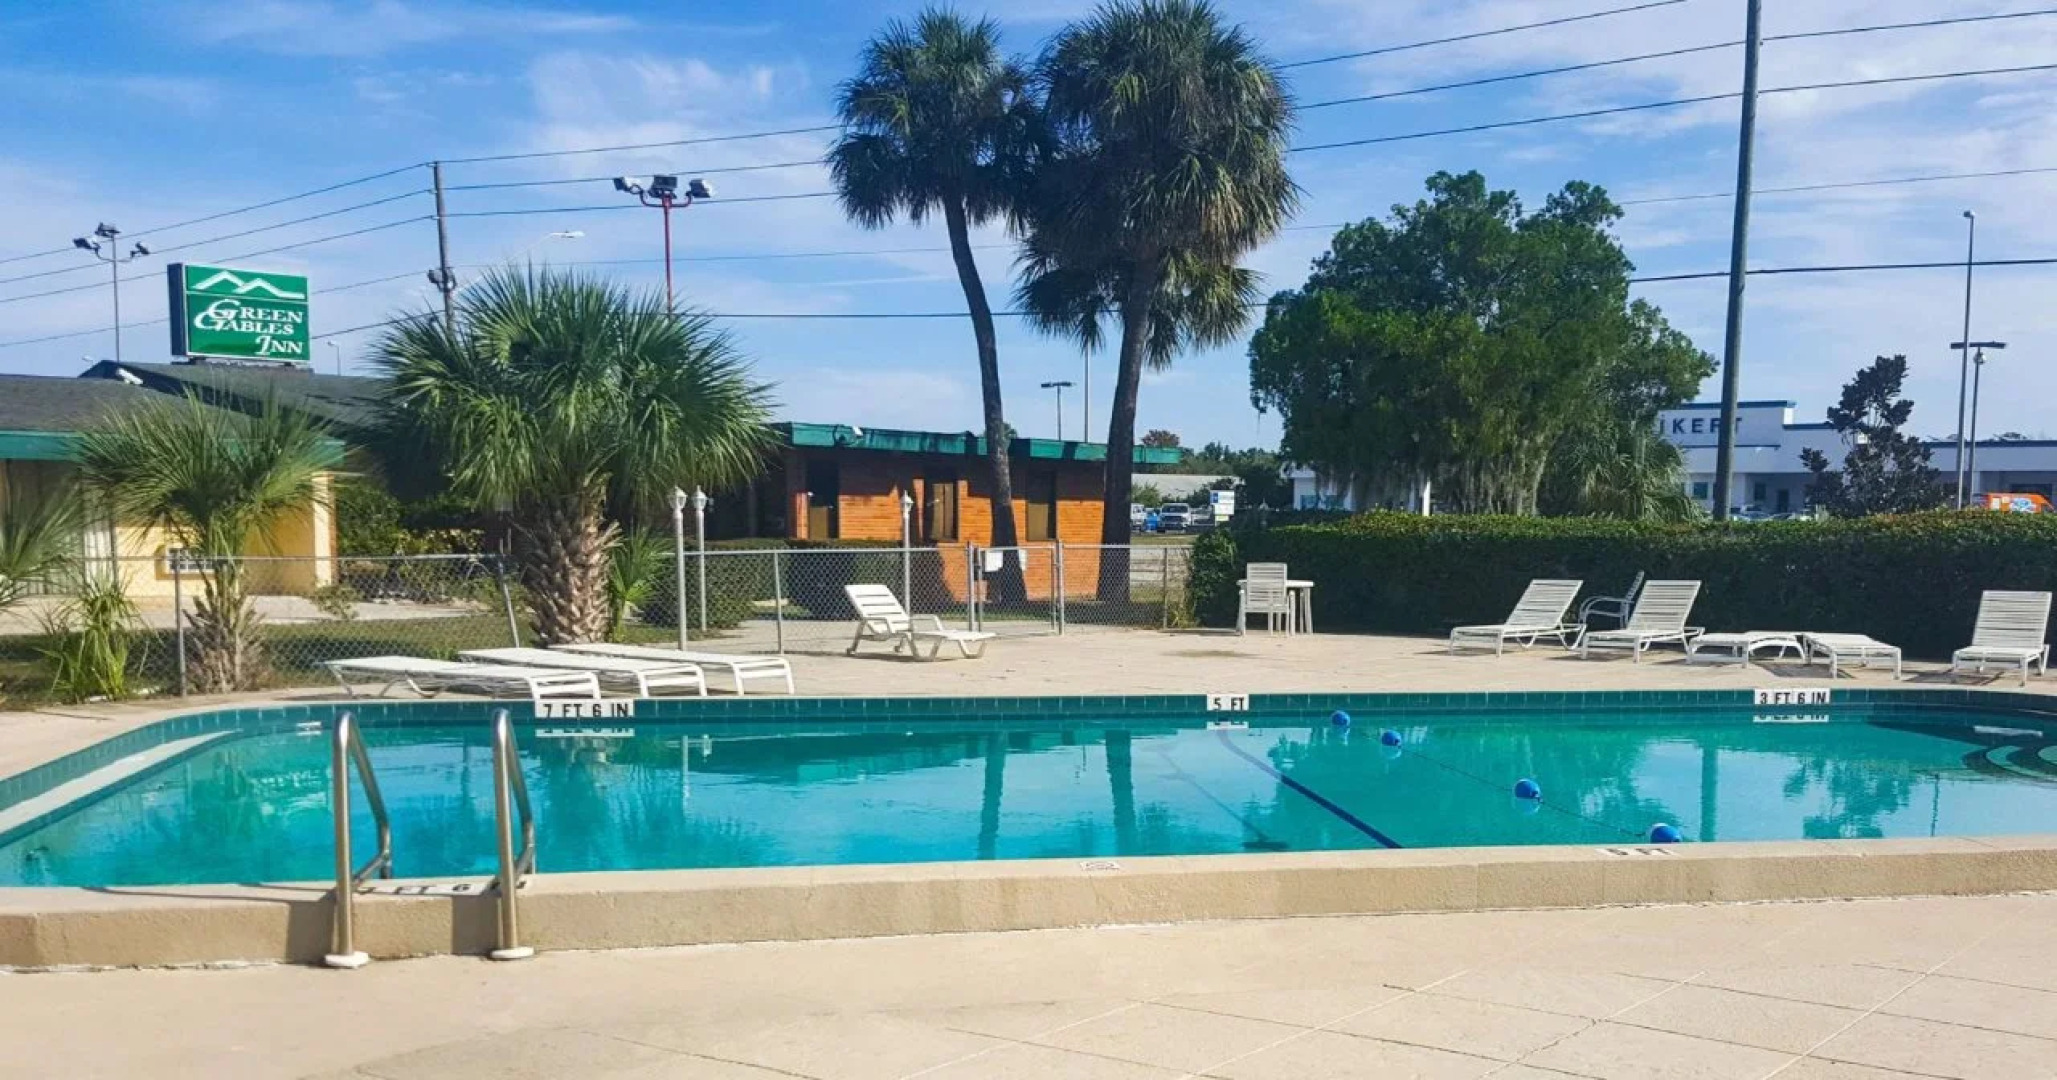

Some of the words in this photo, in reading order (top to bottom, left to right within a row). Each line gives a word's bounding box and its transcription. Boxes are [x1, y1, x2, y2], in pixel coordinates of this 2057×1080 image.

[208, 298, 303, 324] GREEN
[194, 310, 294, 335] GABLES
[255, 335, 303, 356] INN
[1213, 697, 1222, 710] 5
[1230, 697, 1245, 711] FT
[1760, 692, 1769, 704] 3
[1775, 692, 1791, 704] FT
[1797, 692, 1806, 704] 6
[1811, 692, 1827, 704] IN
[543, 703, 554, 717] 7
[562, 703, 583, 717] FT
[592, 703, 602, 717] 6
[611, 703, 629, 717] IN
[452, 883, 471, 893] 6
